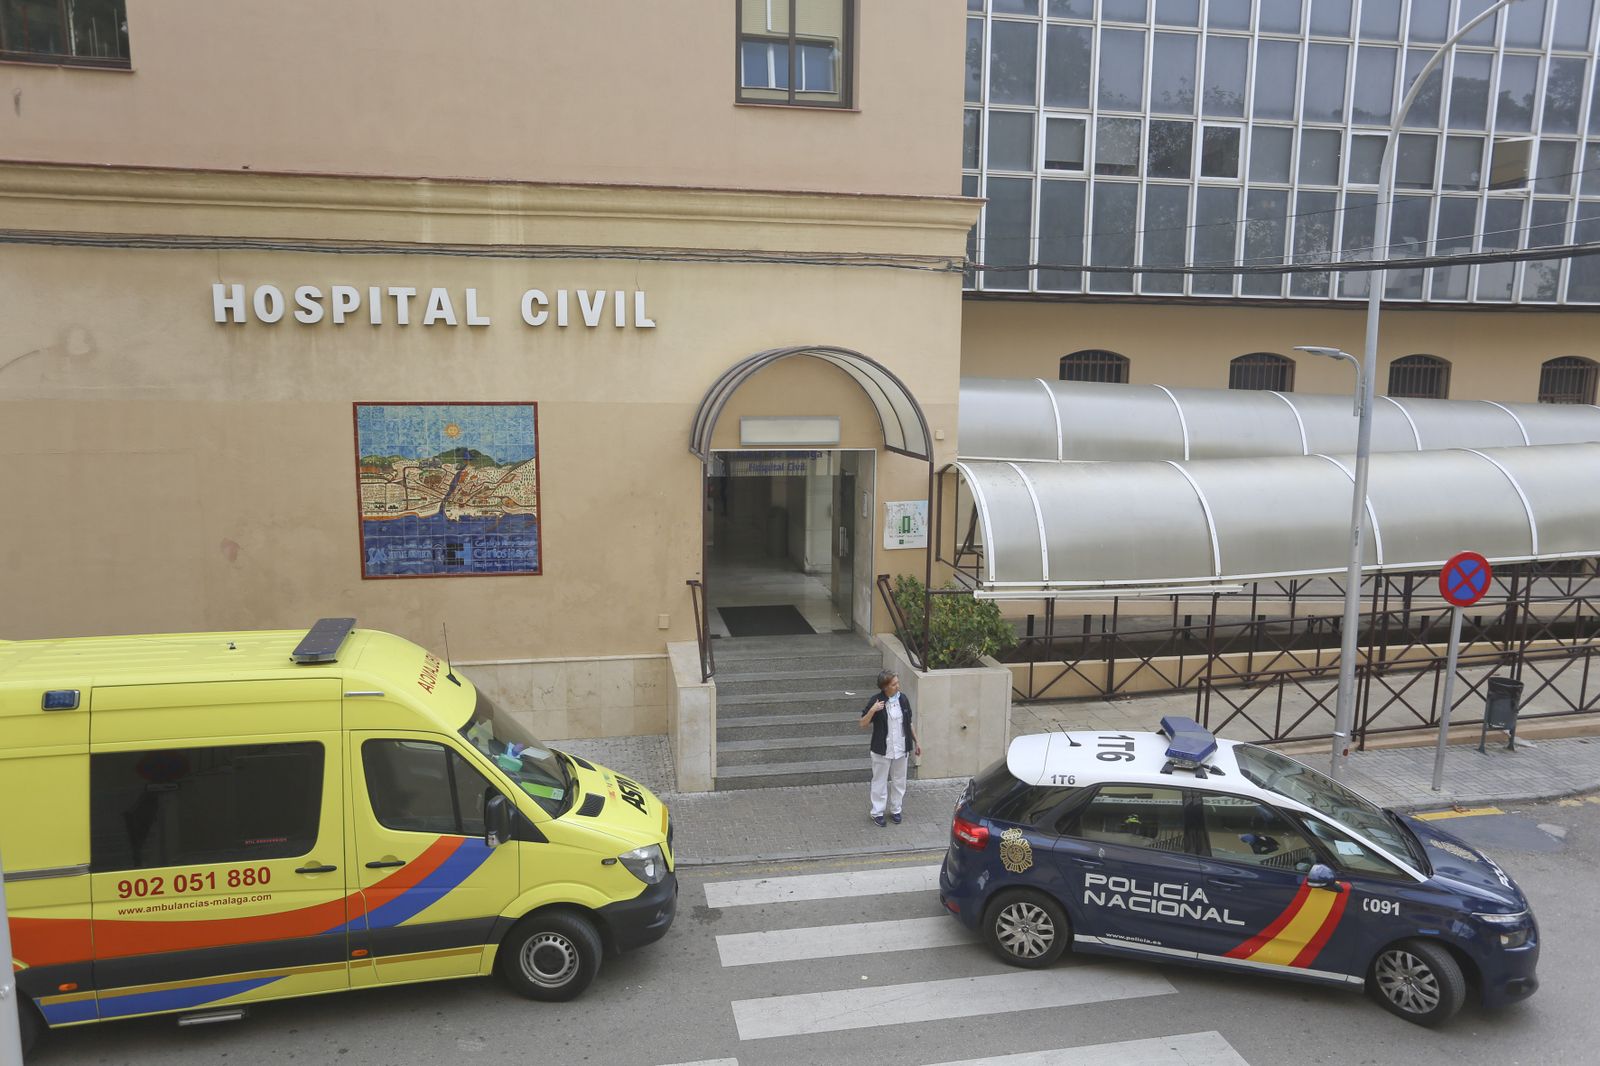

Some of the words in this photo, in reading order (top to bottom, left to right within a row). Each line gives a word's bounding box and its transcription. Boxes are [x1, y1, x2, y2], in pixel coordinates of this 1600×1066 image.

[211, 283, 491, 326] HOSPITAL
[520, 288, 657, 329] CIVIL
[1096, 734, 1136, 762] 1T6
[1050, 774, 1076, 786] 1T6
[117, 876, 165, 899] 902
[173, 871, 216, 893] 051
[227, 866, 272, 888] 880
[1084, 872, 1210, 904] POLICÍA
[118, 893, 273, 916] www.ambulancias-malaga.com
[1083, 889, 1246, 926] NACIONAL
[1370, 898, 1400, 916] 091
[1105, 932, 1162, 946] www.policia.es
